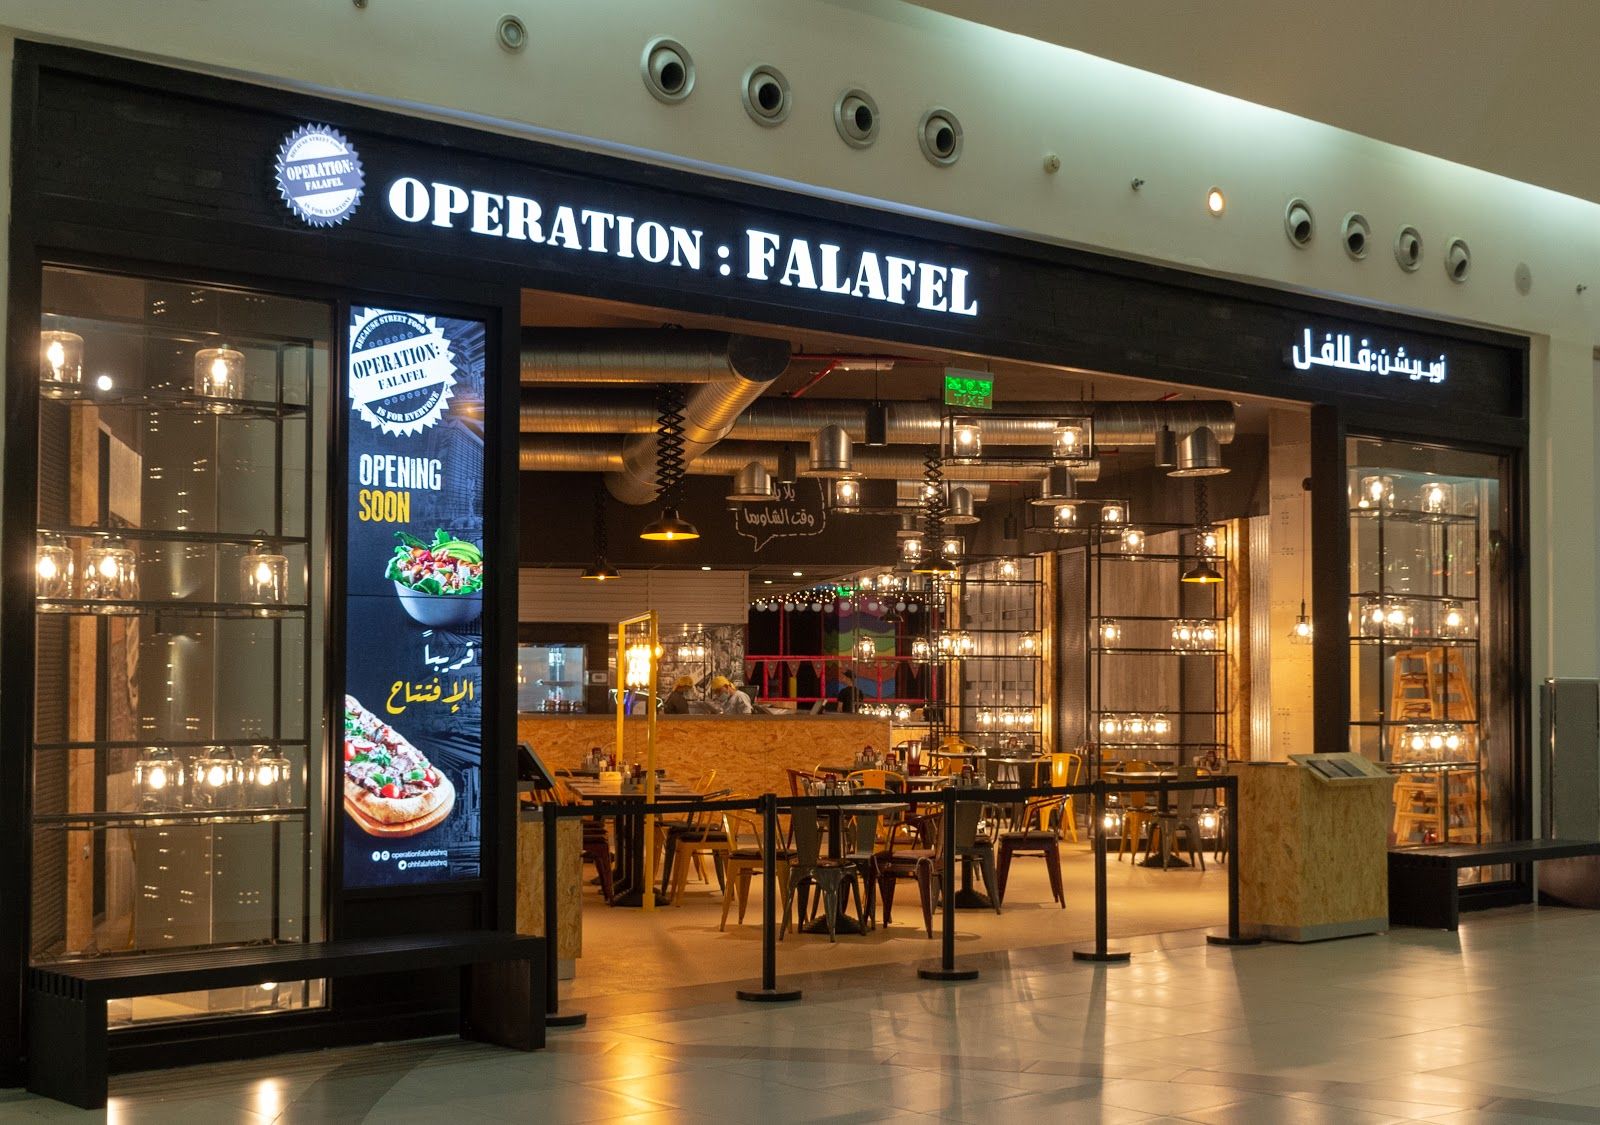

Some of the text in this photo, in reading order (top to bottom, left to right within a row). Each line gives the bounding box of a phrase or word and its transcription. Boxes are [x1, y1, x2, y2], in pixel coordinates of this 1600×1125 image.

[286, 159, 354, 181] OPERATION:
[304, 177, 344, 191] FALAFEL
[388, 177, 703, 270] OPERATION
[746, 229, 978, 316] FALAFEL
[355, 314, 426, 349] BECAUSE STREET FOOD
[352, 342, 440, 380] OPERATION:
[378, 368, 428, 390] FALAFEL
[376, 391, 440, 422] IS FOR EVERYONE
[360, 453, 441, 491] OPENING
[358, 489, 410, 523] SOON
